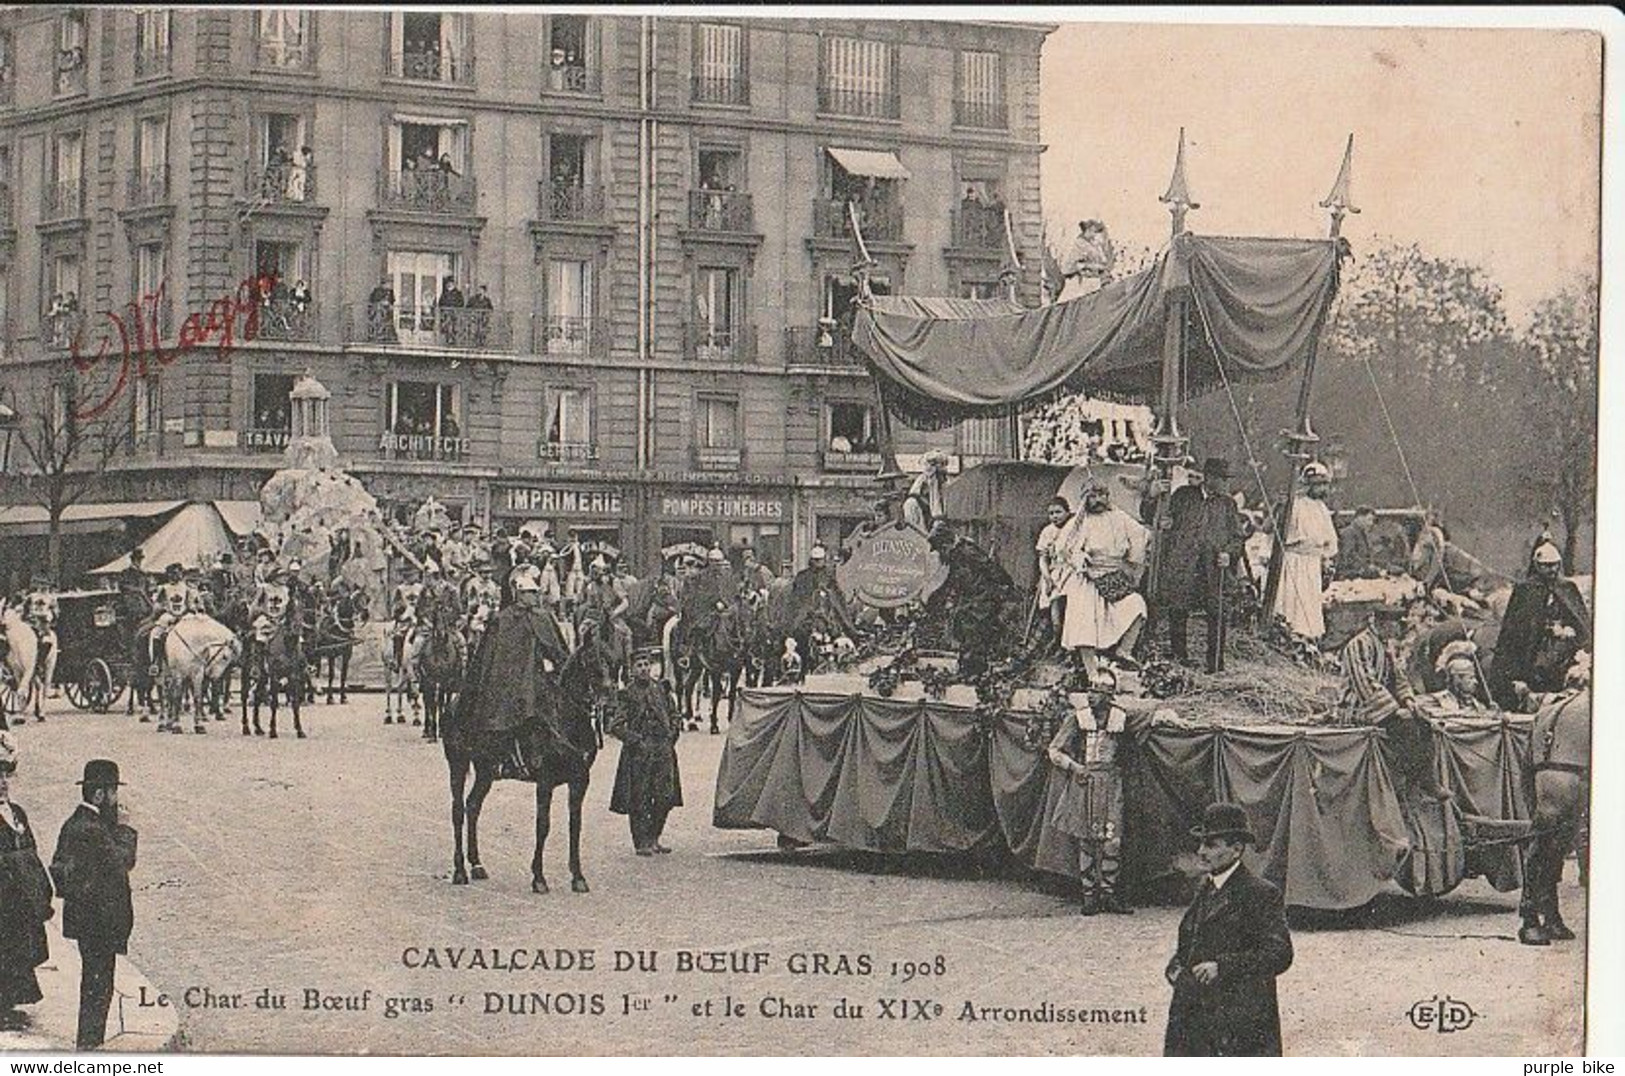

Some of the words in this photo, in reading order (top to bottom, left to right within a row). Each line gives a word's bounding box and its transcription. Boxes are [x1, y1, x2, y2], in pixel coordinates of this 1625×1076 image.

[246, 432, 291, 447] TRAVA
[379, 434, 471, 456] ARCHITECTE
[507, 488, 623, 512] IMPRIMERIE
[662, 498, 714, 517] POMPES
